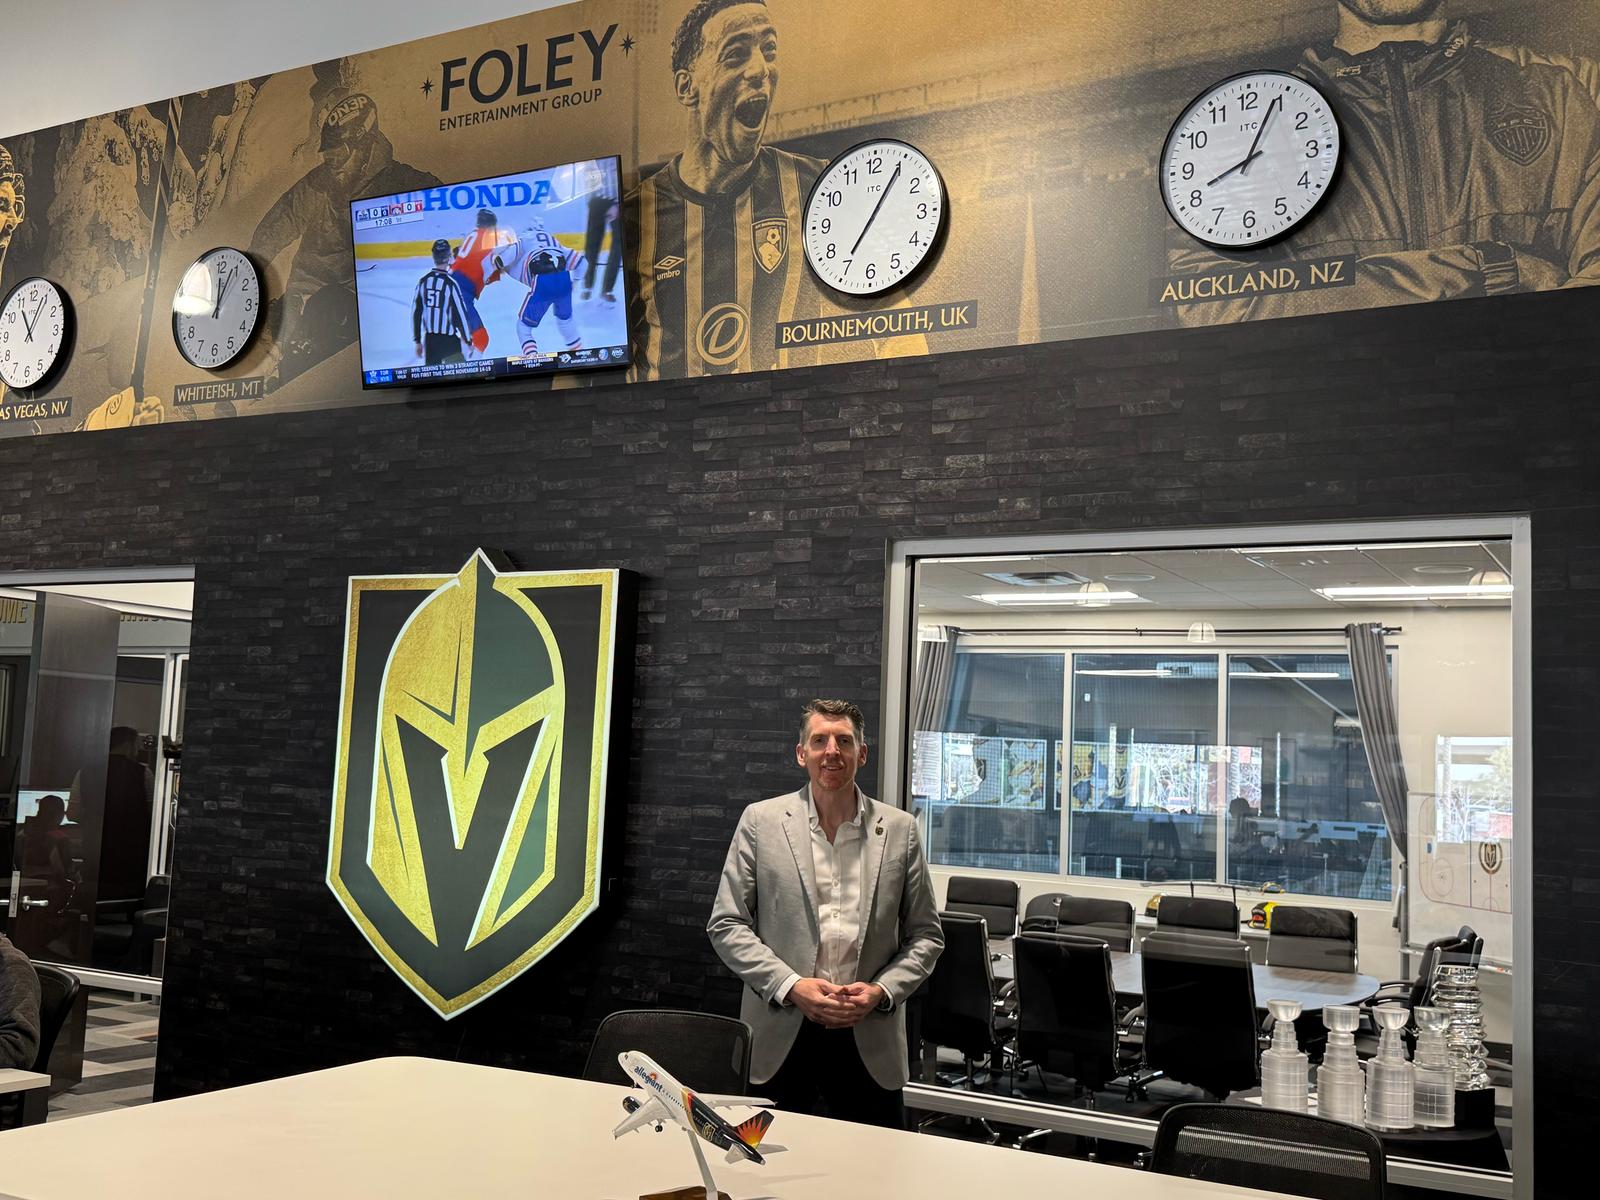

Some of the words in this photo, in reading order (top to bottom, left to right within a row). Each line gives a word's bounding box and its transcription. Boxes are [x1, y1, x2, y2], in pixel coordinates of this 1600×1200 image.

[441, 23, 619, 112] FOLEY
[1237, 91, 1258, 111] 12
[1275, 94, 1283, 112] 1
[439, 98, 549, 131] ENTERTAINMENT
[552, 88, 602, 110] GROUP
[1208, 105, 1226, 124] 11
[1240, 122, 1258, 132] ITC
[1295, 112, 1309, 130] 2
[1187, 131, 1207, 150] 10
[1305, 139, 1319, 158] 3
[866, 157, 882, 174] 12
[1182, 162, 1195, 180] 9
[843, 168, 857, 185] 11
[1297, 170, 1311, 189] 4
[867, 185, 881, 193] ITC
[909, 178, 920, 194] 2
[423, 180, 552, 212] HONDA
[826, 190, 842, 207] 10
[1190, 189, 1202, 208] 8
[406, 203, 413, 211] 0
[916, 203, 927, 219] 3
[1274, 197, 1287, 215] 5
[1212, 207, 1225, 225] 7
[1242, 210, 1256, 228] 6
[821, 218, 831, 234] 9
[909, 231, 919, 247] 4
[826, 243, 836, 259] 8
[216, 261, 227, 274] 12
[843, 259, 853, 276] 7
[890, 253, 901, 269] 5
[234, 265, 239, 277] 1
[657, 269, 681, 281] umbro
[865, 263, 876, 279] 6
[242, 278, 248, 291] 2
[1160, 268, 1301, 302] AUCKLAND,
[1309, 261, 1345, 284] NZ
[18, 298, 25, 309] 11
[29, 290, 38, 301] 12
[426, 288, 440, 307] 51
[50, 306, 57, 318] 2
[245, 299, 252, 312] 3
[8, 312, 16, 323] 10
[782, 310, 933, 344] BOURNEMOUTH,
[941, 306, 969, 327] UK
[53, 324, 59, 336] 3
[188, 326, 195, 339] 8
[239, 320, 246, 332] 4
[3, 331, 9, 343] 9
[227, 337, 234, 349] 5
[48, 344, 54, 355] 4
[198, 340, 205, 352] 7
[211, 343, 218, 356] 6
[4, 349, 11, 361] 8
[13, 362, 18, 374] 7
[24, 366, 30, 377] 6
[37, 359, 43, 371] 5
[177, 383, 238, 402] WHITEFISH,
[241, 380, 261, 395] MT
[14, 404, 48, 418] VEGAS,
[51, 400, 68, 415] NV
[634, 1065, 663, 1092] allegiant
